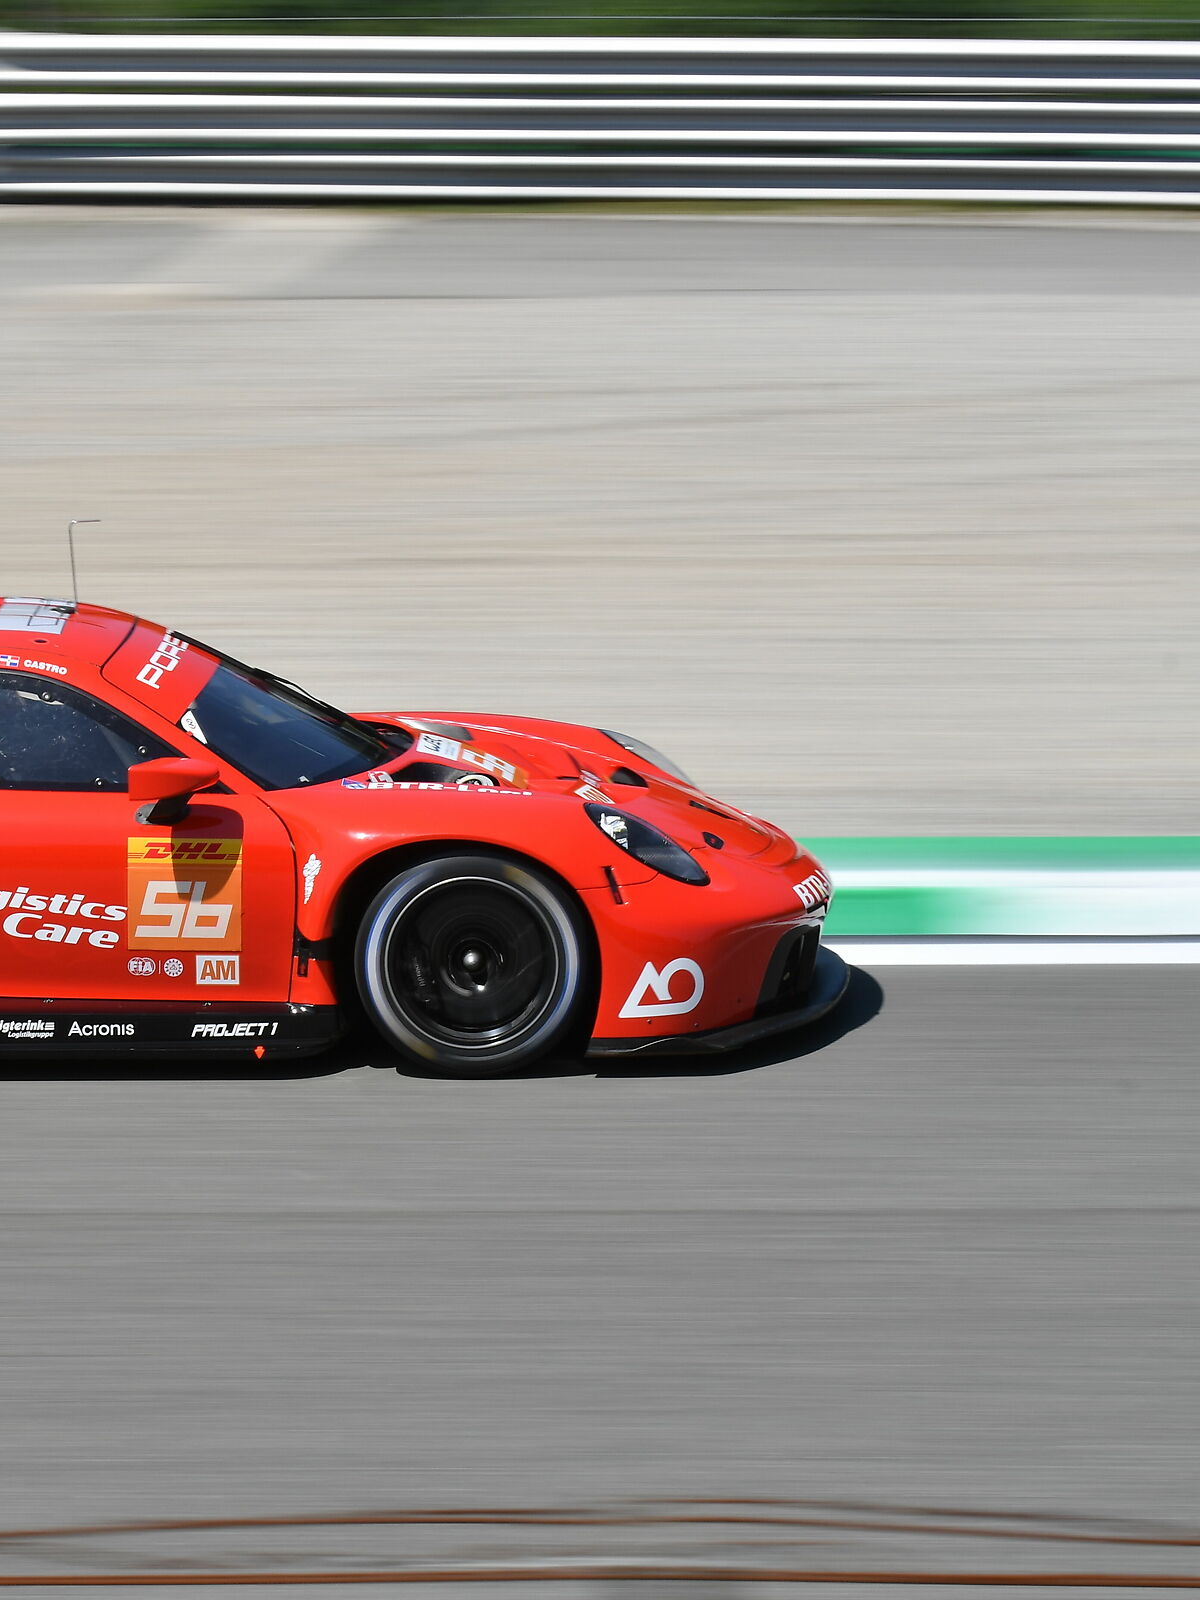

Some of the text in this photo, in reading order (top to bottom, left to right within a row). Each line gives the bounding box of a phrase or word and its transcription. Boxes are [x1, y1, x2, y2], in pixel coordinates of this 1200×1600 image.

[23, 659, 67, 675] CASTRO
[144, 841, 230, 861] DHL
[135, 880, 233, 938] 56
[0, 912, 120, 949] Care
[200, 960, 236, 981] AM
[7, 1031, 54, 1039] Logistikgruppe
[68, 1021, 135, 1037] Acronis
[191, 1022, 279, 1038] PROJECT 1
